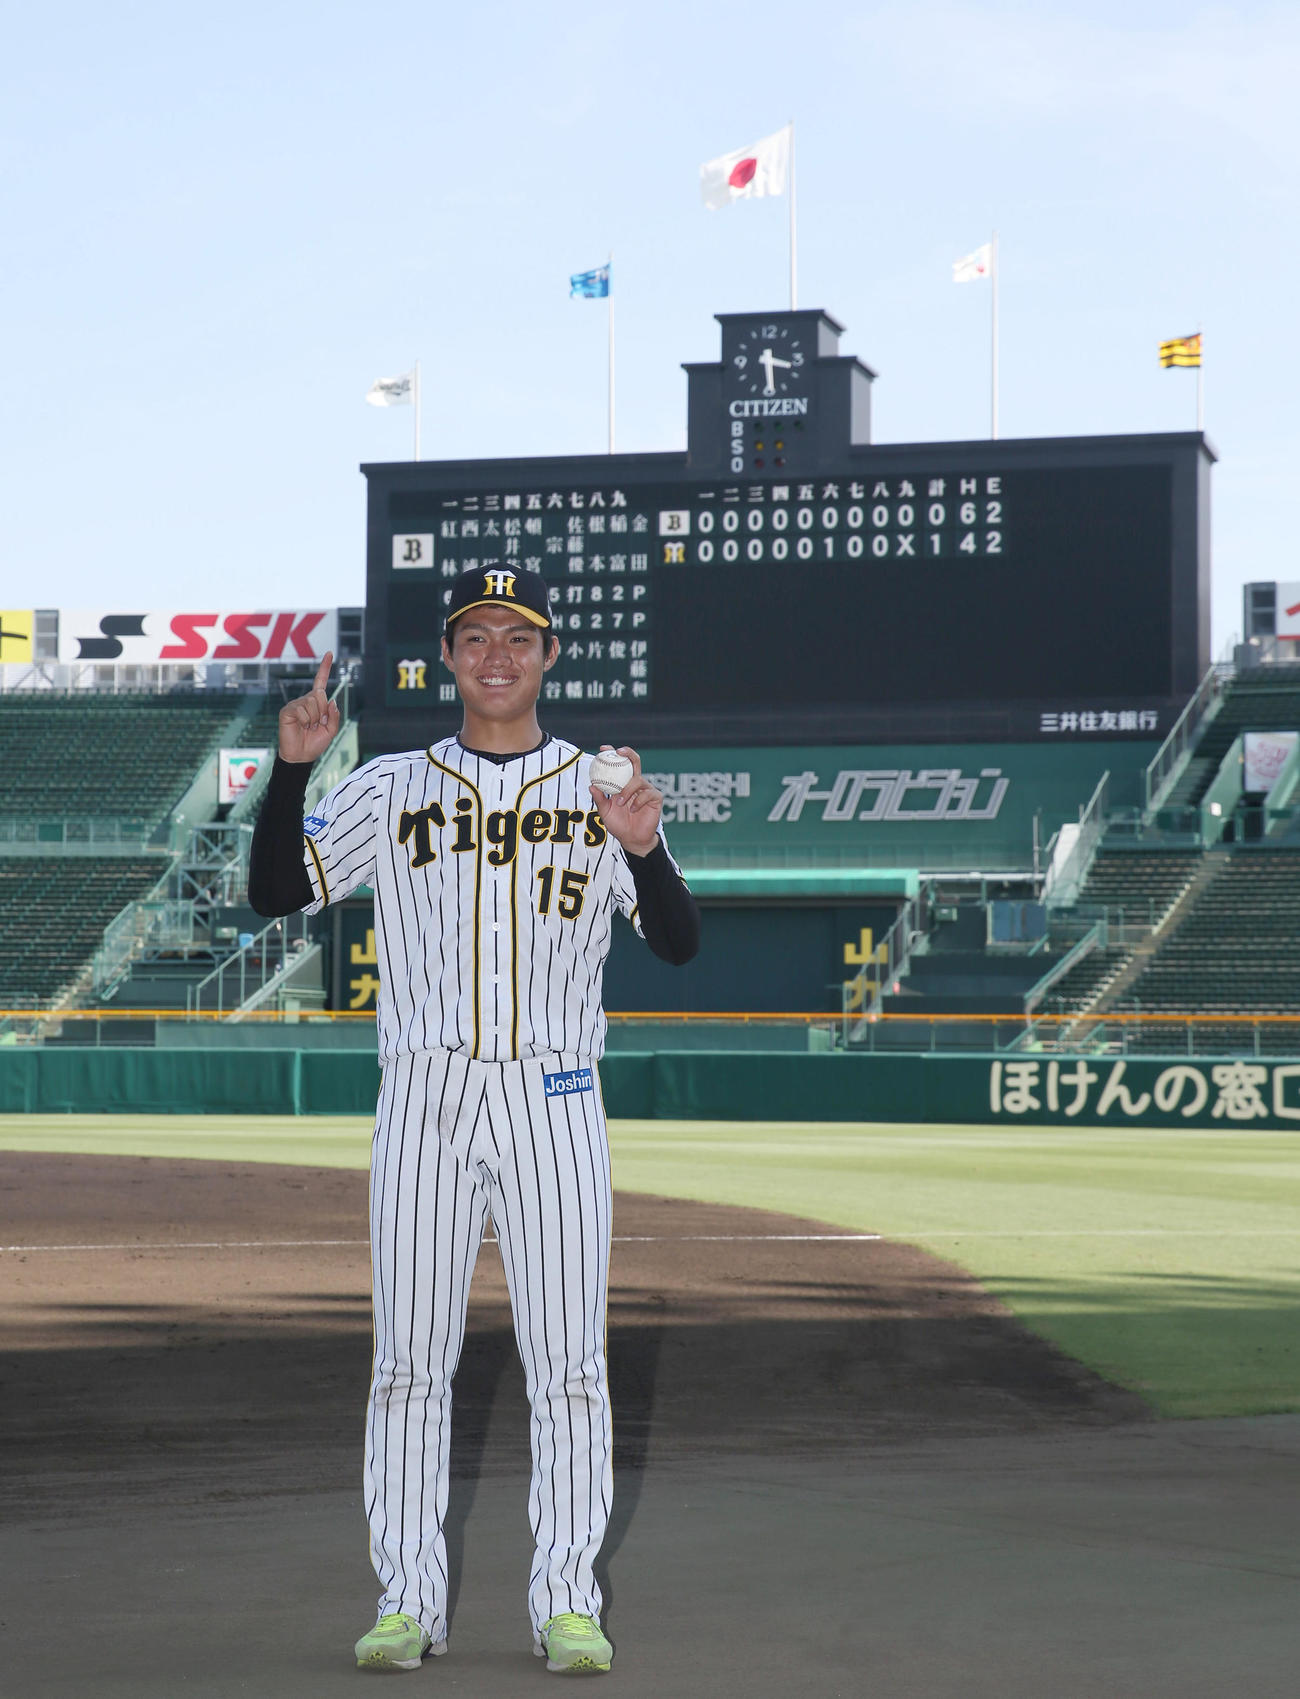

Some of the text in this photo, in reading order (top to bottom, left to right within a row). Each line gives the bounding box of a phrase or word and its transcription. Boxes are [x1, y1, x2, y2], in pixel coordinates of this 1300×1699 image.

[761, 325, 778, 339] 12
[733, 355, 748, 369] 9
[729, 397, 808, 418] CITIZEN
[697, 511, 714, 534] 0
[722, 510, 739, 533] 0
[747, 509, 764, 532] 0
[772, 508, 789, 531] 0
[796, 507, 814, 530] 0
[821, 506, 839, 529] 0
[846, 505, 864, 529] 0
[872, 504, 889, 528] 0
[897, 504, 914, 527] 0
[928, 503, 945, 526] 0
[959, 501, 976, 525] 6
[986, 500, 1002, 524] 2
[697, 540, 714, 563] 0
[722, 539, 739, 562] 0
[747, 538, 764, 561] 0
[771, 537, 789, 560] 0
[796, 536, 814, 560] 0
[823, 536, 834, 558] 1
[846, 535, 864, 558] 0
[872, 534, 889, 557] 0
[896, 533, 915, 556] X
[930, 533, 940, 555] 1
[959, 532, 977, 554] 4
[986, 531, 1002, 554] 2
[591, 585, 603, 601] 8
[611, 584, 625, 601] 2
[632, 584, 647, 601] P
[569, 613, 581, 630] 6
[590, 613, 603, 629] 2
[612, 612, 624, 628] 7
[632, 612, 646, 628] P
[159, 612, 327, 659] SSK
[1040, 710, 1158, 732] 三井住友銀行
[661, 797, 732, 823] CTRIC
[398, 797, 608, 868] Tigers
[537, 865, 591, 920] 15
[546, 1072, 592, 1094] Joshin
